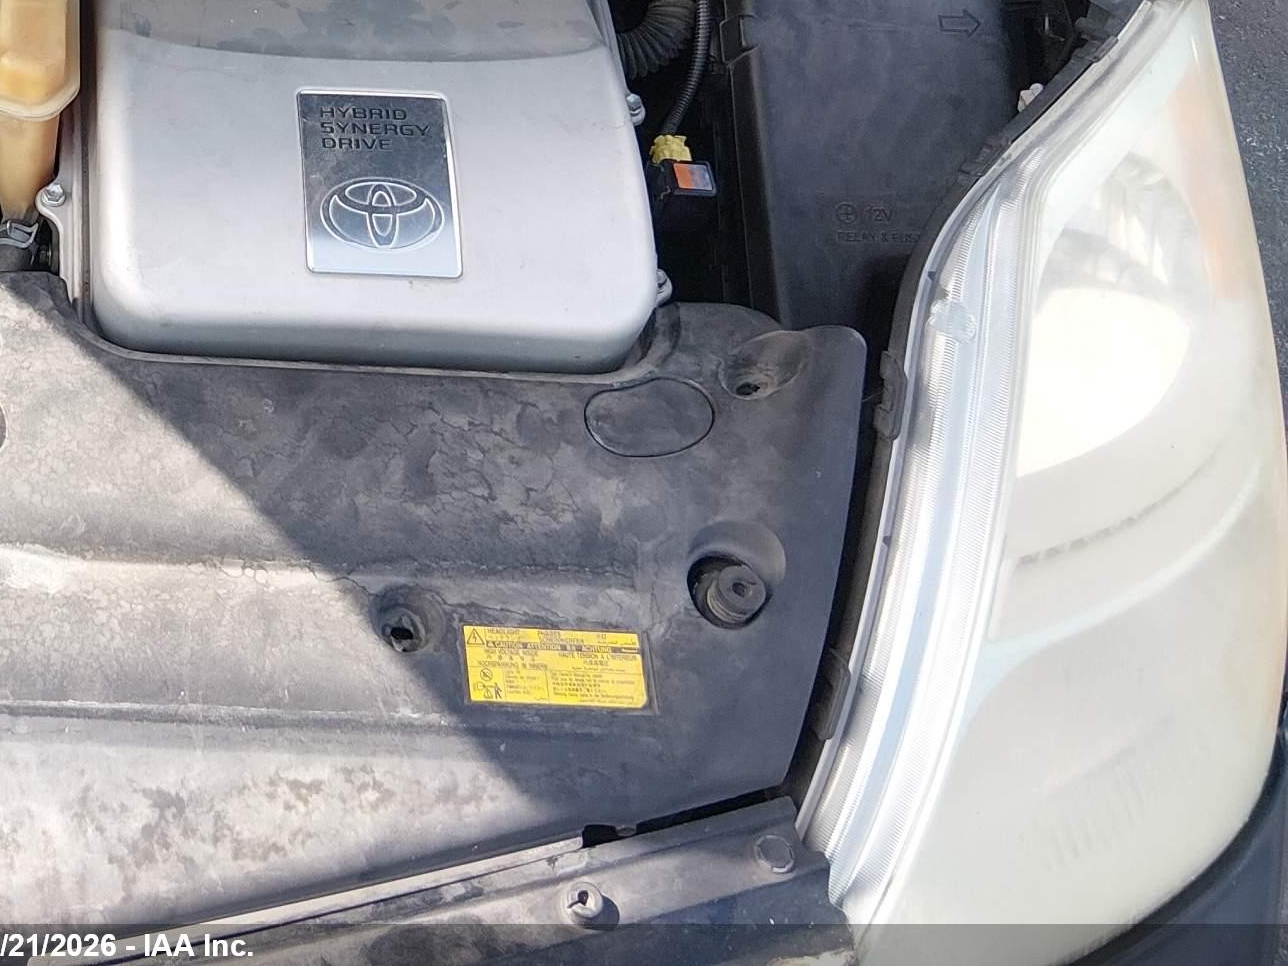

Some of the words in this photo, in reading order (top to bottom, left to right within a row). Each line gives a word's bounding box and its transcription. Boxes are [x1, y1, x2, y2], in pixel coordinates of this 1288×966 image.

[319, 106, 407, 121] HYBRID
[320, 122, 430, 136] SYNERGY
[321, 137, 392, 151] DRIVE
[495, 641, 522, 649] CAUTION
[527, 642, 561, 651] ATTENTION
